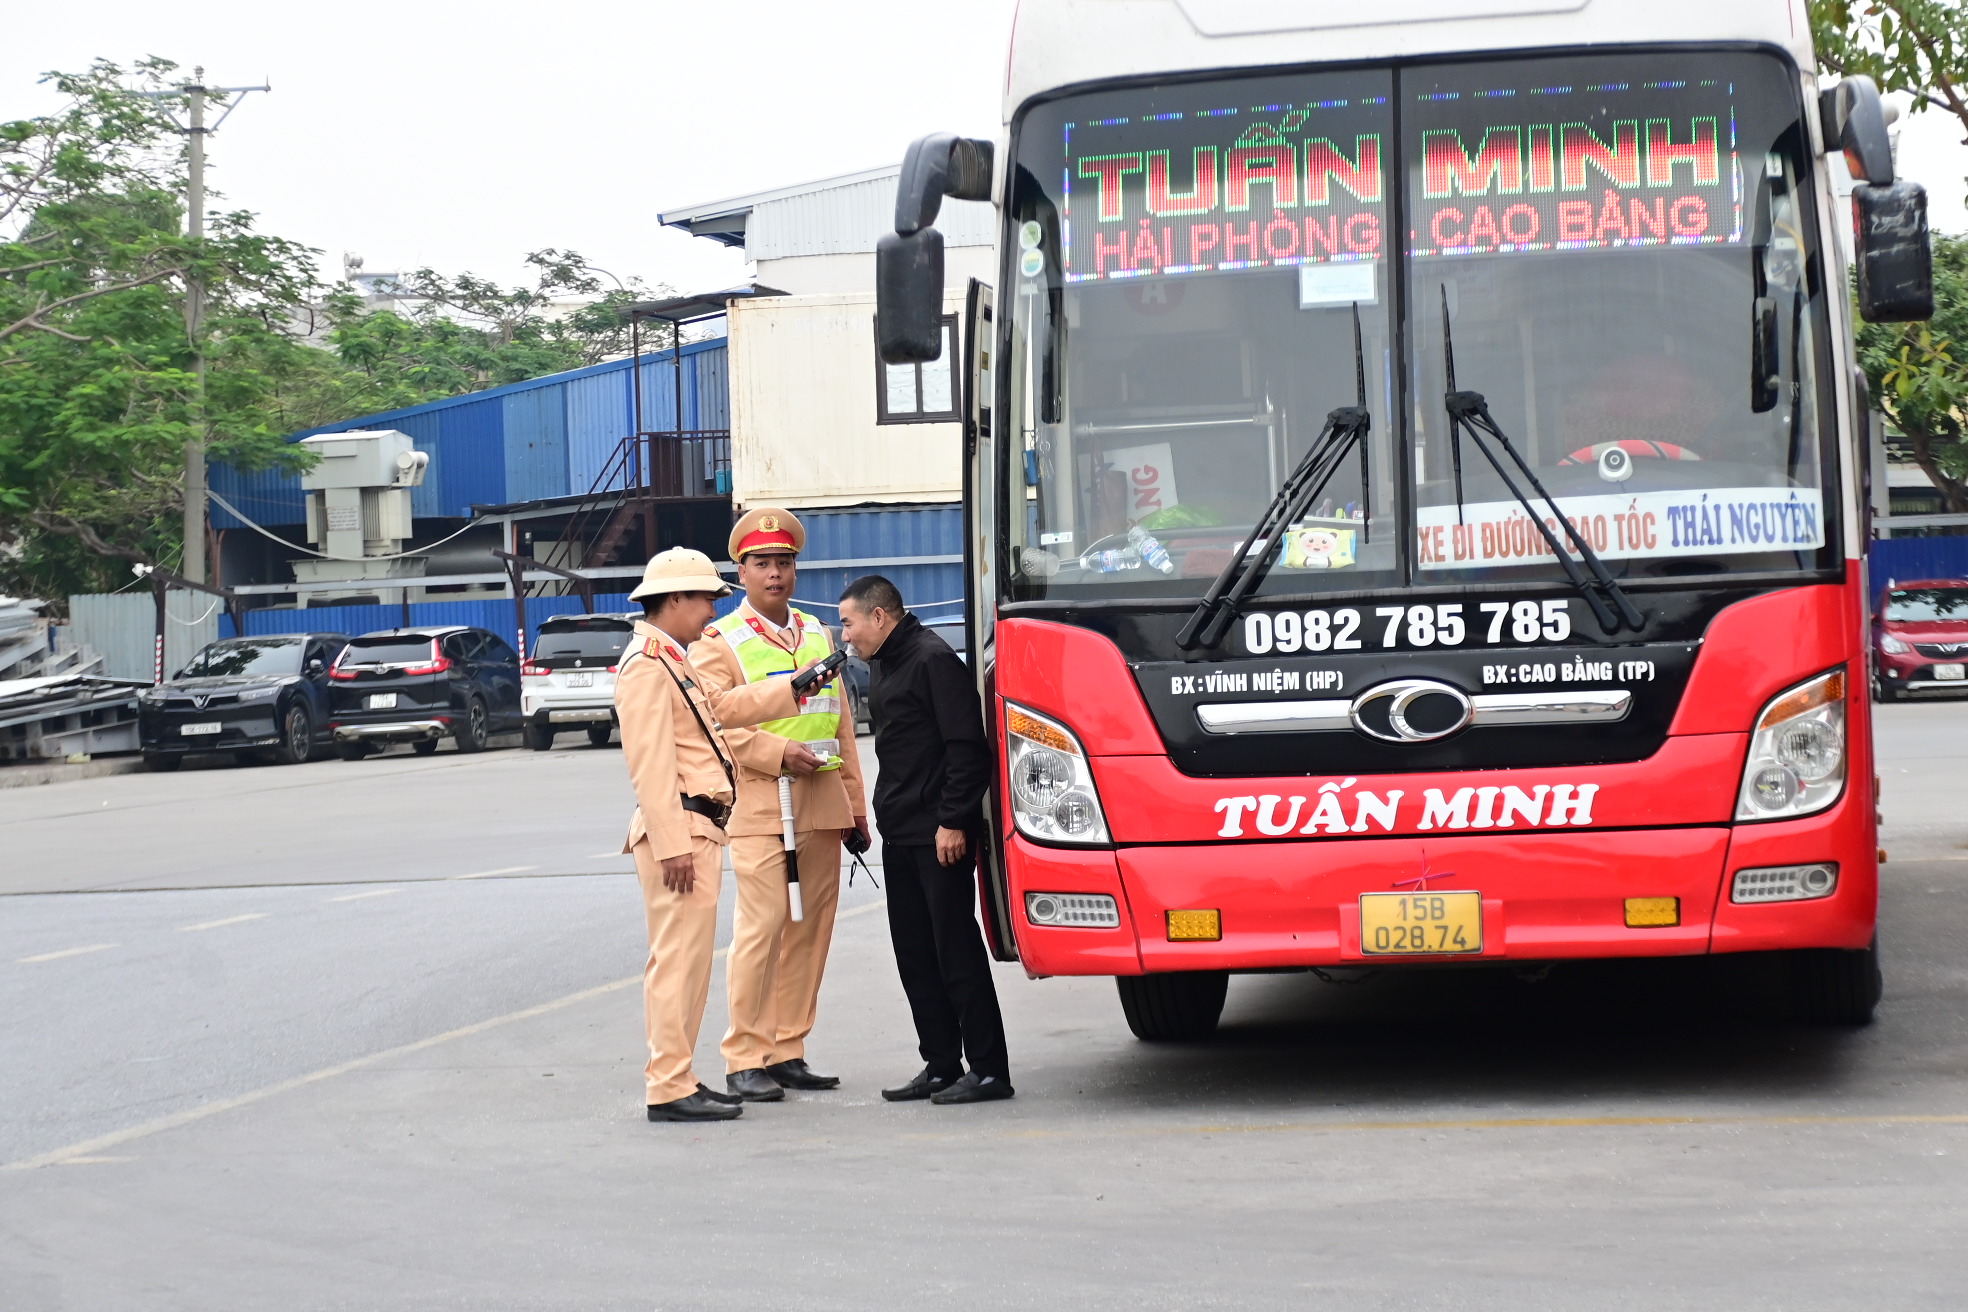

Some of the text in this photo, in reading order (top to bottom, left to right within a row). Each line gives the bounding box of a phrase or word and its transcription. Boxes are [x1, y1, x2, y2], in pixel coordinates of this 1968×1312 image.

[1079, 109, 1719, 222] TUẤN MINH
[1096, 218, 1172, 273] HẢI
[1191, 208, 1381, 264] PHÒNG
[1431, 203, 1540, 248] CAO
[1419, 491, 1819, 564] XE ĐI ĐƯỜNG CAO TỐC THÁI NGUYÊN
[1245, 600, 1571, 654] 0982 785 785
[1252, 668, 1300, 694] NIỆM
[1305, 671, 1344, 692] (HP)
[1561, 655, 1613, 682] BẰNG
[1618, 661, 1655, 682] (TP)
[1214, 778, 1599, 838] TUẤN MINH
[1398, 897, 1445, 921] 15B
[1375, 925, 1467, 951] 028.74
